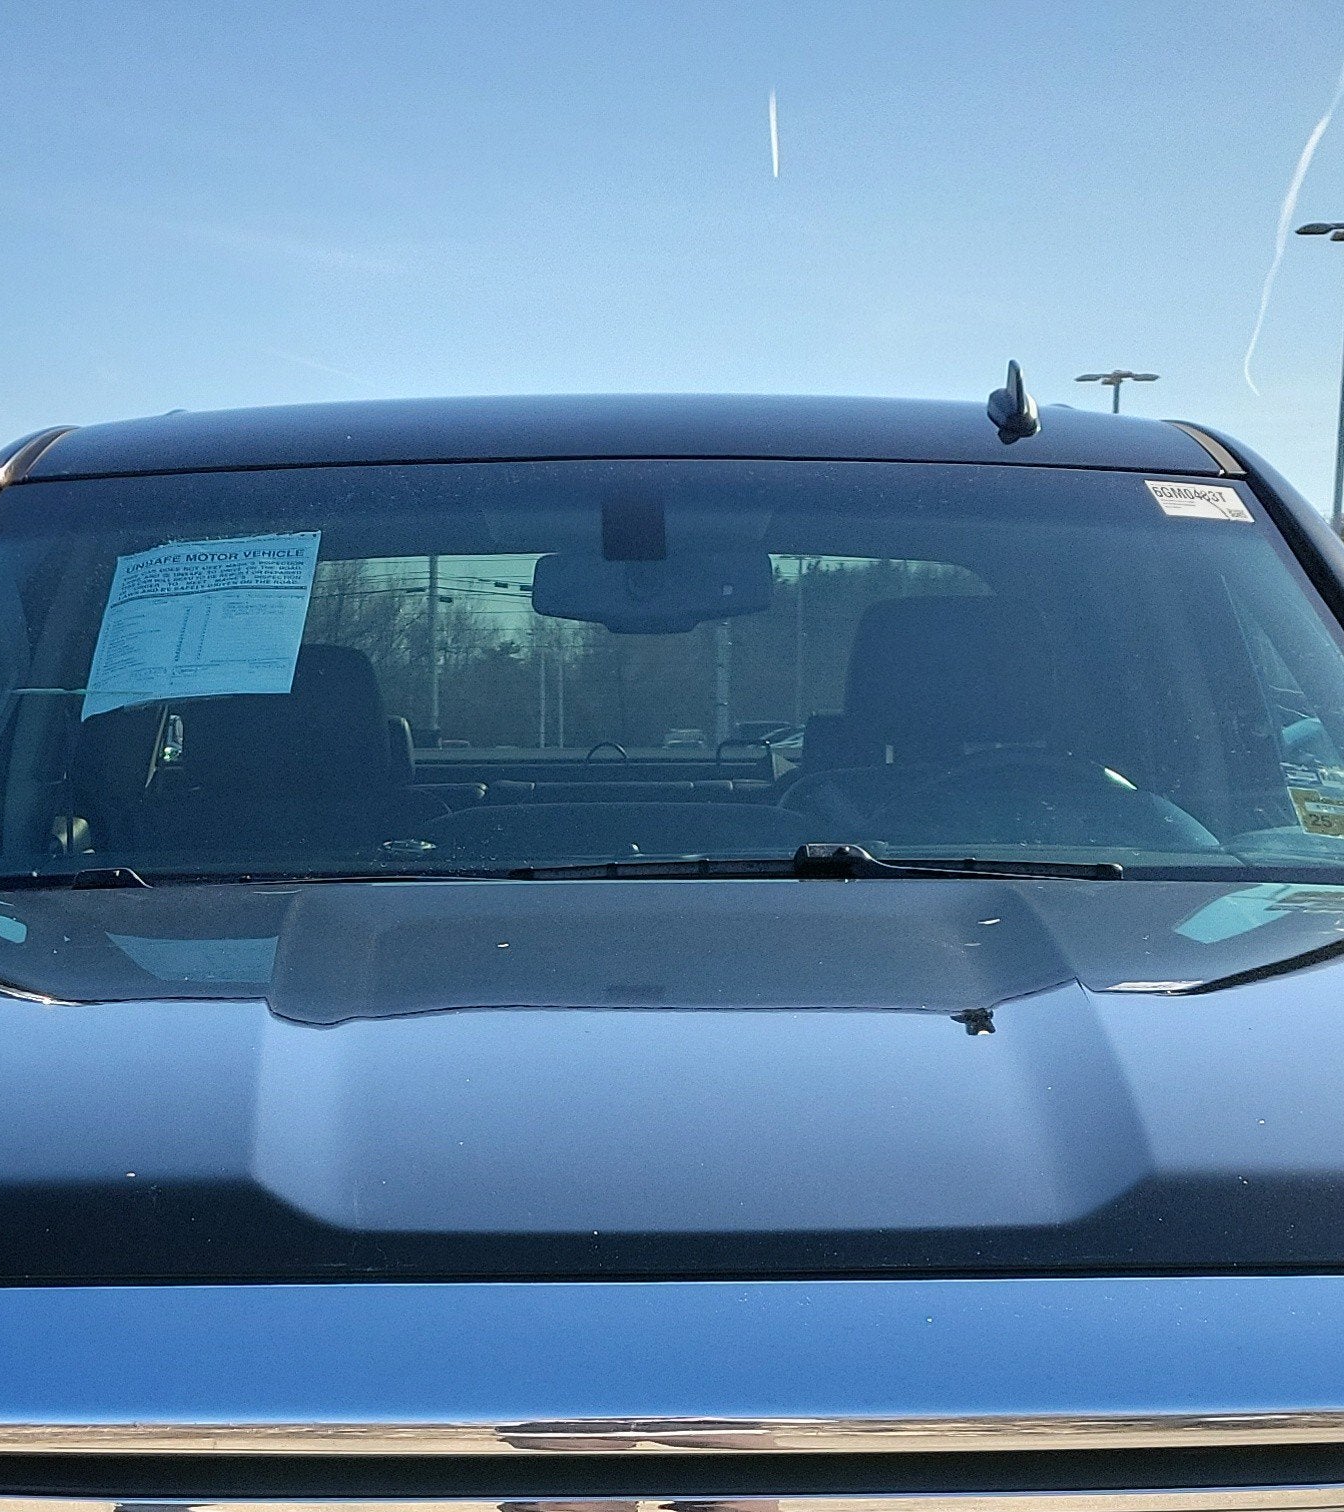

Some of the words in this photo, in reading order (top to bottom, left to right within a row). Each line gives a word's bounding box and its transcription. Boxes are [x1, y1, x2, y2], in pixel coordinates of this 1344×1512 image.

[126, 556, 181, 573] UNSAFE
[185, 552, 239, 562] MOTOR
[243, 549, 305, 558] VEHICLE
